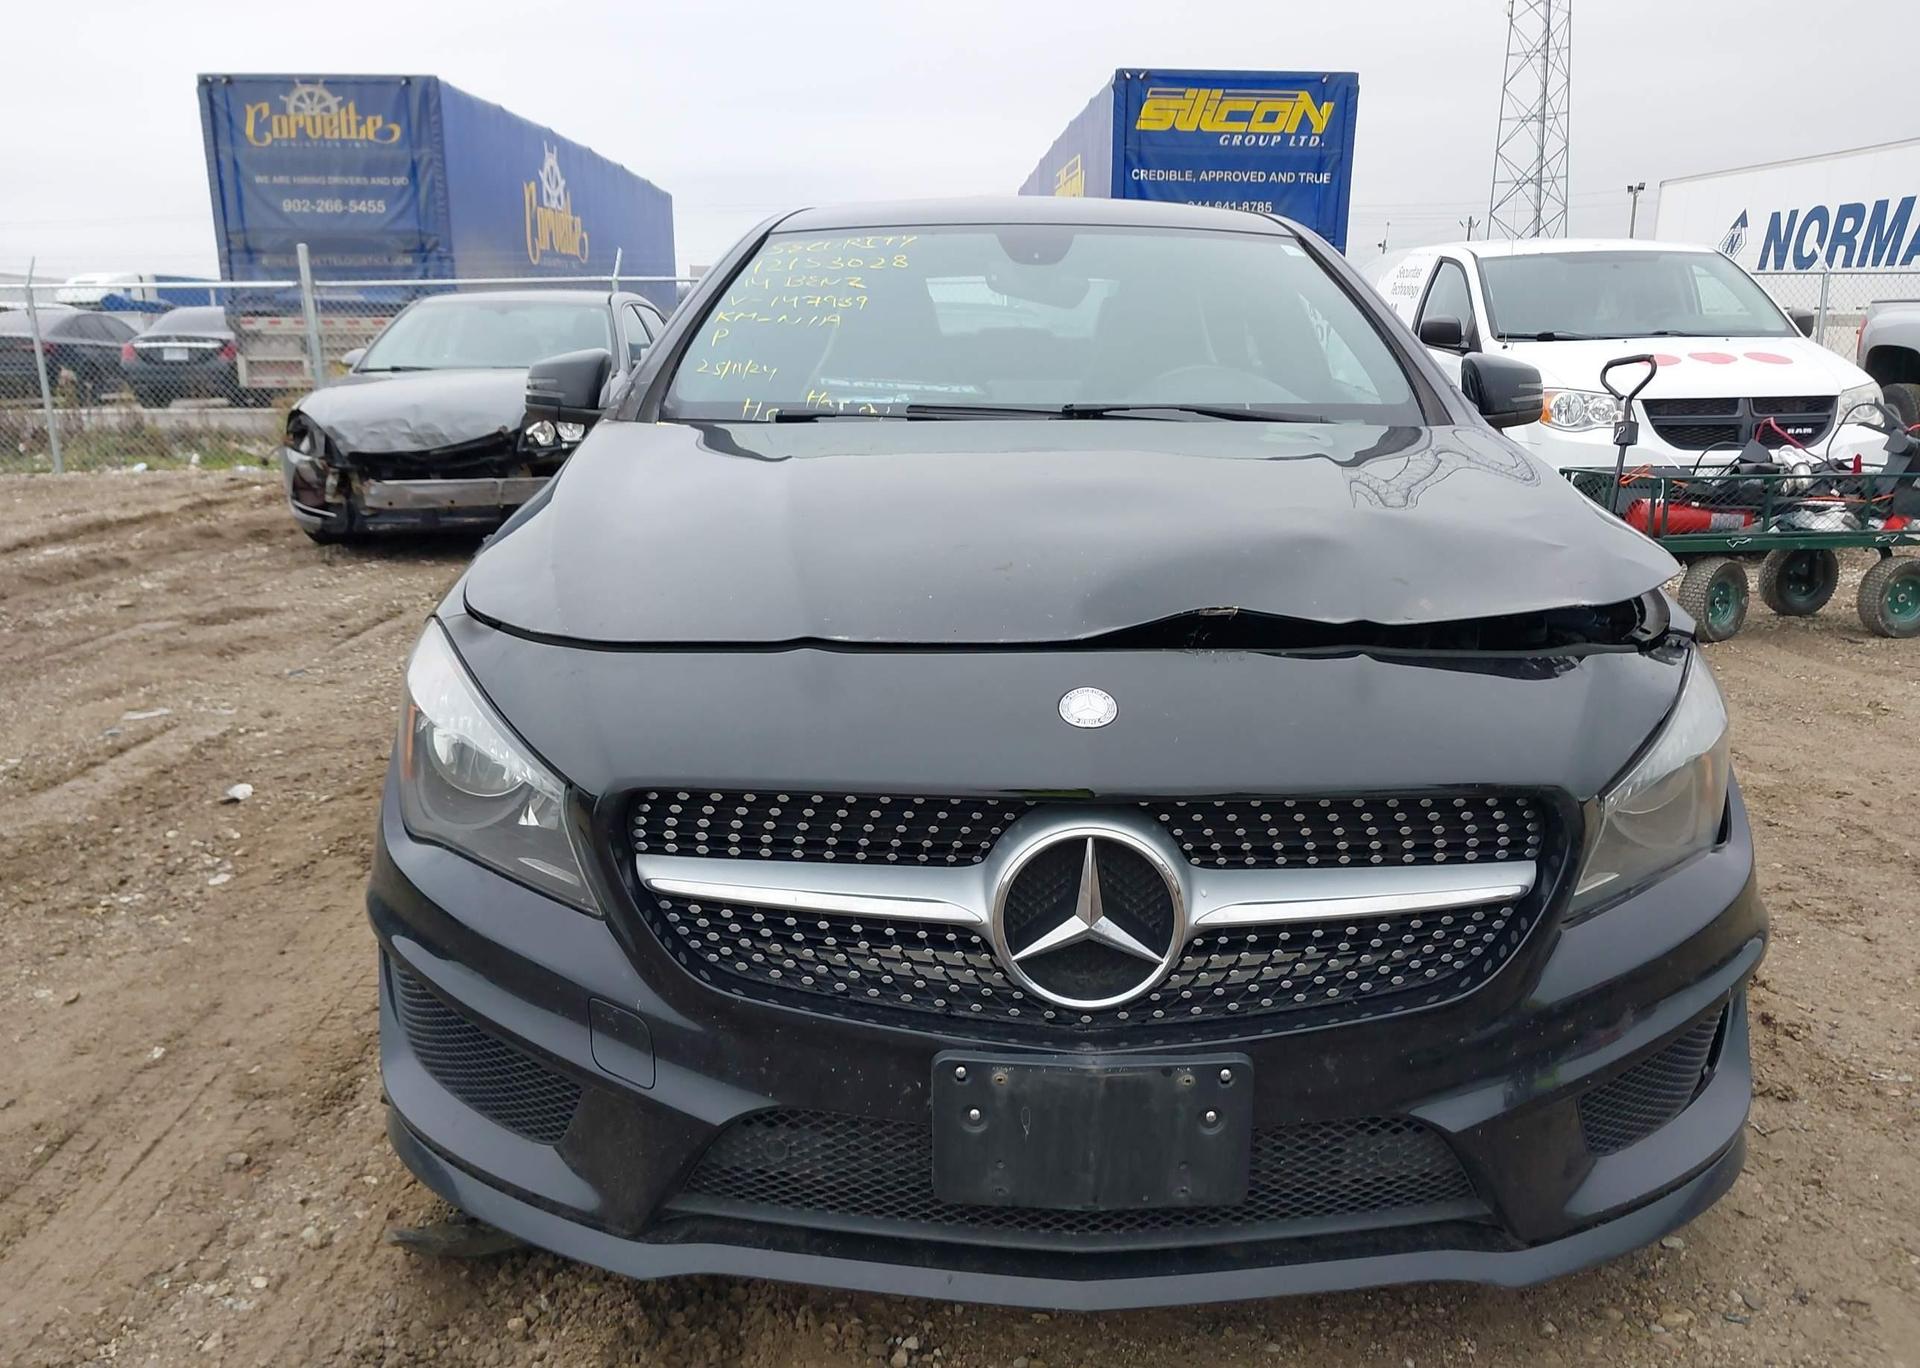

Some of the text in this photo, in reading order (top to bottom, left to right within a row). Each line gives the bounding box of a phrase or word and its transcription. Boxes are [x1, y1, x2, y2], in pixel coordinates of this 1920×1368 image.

[245, 101, 401, 147] Corvette
[1219, 134, 1325, 147] GROUP LTD.
[255, 175, 268, 185] WE
[328, 175, 368, 186] DRIVERS
[371, 176, 390, 186] AND
[1132, 169, 1331, 184] CREDIBLE, APPROVED AND TRUE
